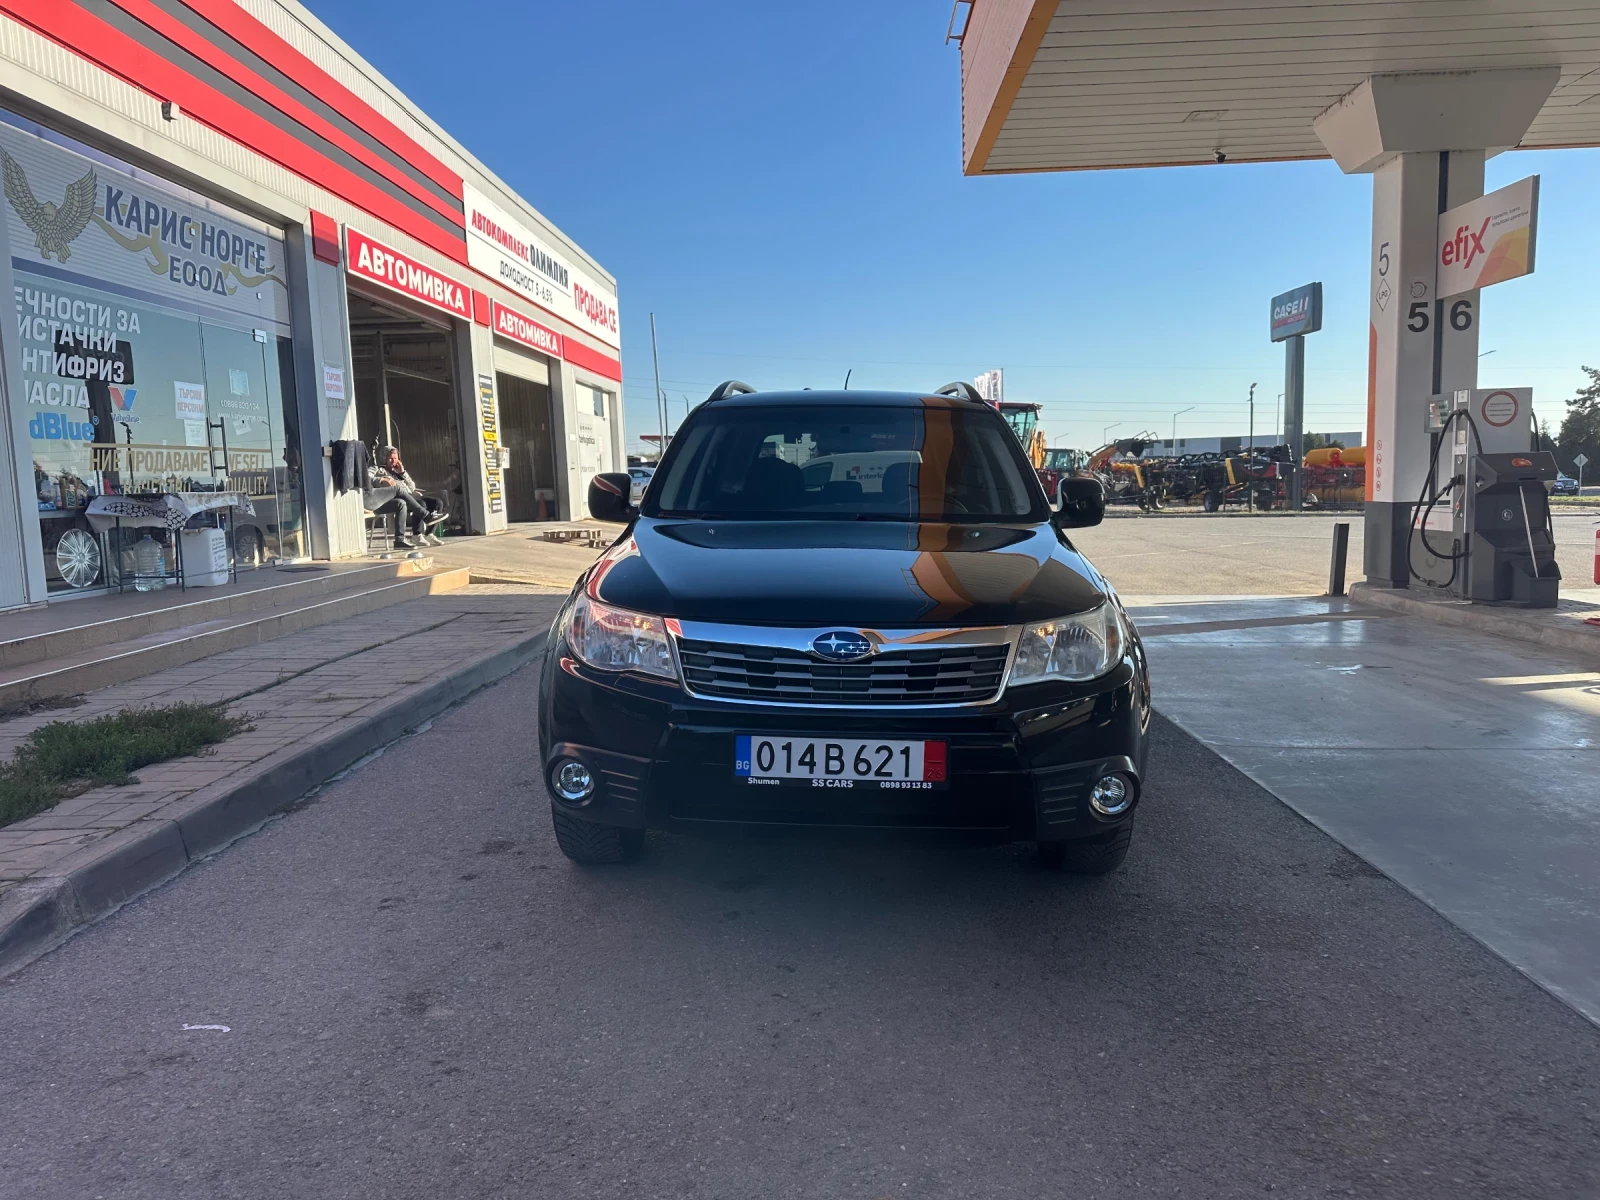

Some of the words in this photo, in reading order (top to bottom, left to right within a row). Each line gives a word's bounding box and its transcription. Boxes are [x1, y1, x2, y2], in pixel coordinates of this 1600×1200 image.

[105, 185, 193, 249] КАРИС
[201, 223, 265, 274] НОРГЕ
[1441, 216, 1491, 269] efix
[472, 209, 528, 262] АВТОКОМПЛЕКС
[530, 244, 568, 289] ОЛИМПИЯ
[1379, 242, 1389, 276] 5
[169, 256, 227, 296] ЕООД
[357, 243, 465, 312] АВТОМИВКА
[500, 260, 534, 293] ДОХОДНОСТ
[574, 282, 608, 330] ПРОДАВА
[608, 307, 616, 333] СЕ
[1274, 300, 1299, 320] CASE
[1378, 289, 1388, 299] LPG
[117, 310, 141, 334] ЗА
[499, 310, 558, 353] АВТОМИВКА
[1407, 302, 1429, 332] 5
[1450, 300, 1472, 331] 6
[23, 348, 124, 383] НТИФРИЗ
[89, 449, 121, 472] НИЕ
[125, 450, 208, 473] ПРОДАВАМЕ
[242, 454, 267, 472] SELL
[224, 476, 268, 495] QUALITY
[735, 760, 750, 771] BG
[927, 767, 942, 778] 26
[747, 777, 780, 785] Shumen
[812, 779, 825, 787] SS
[826, 779, 853, 788] CARS
